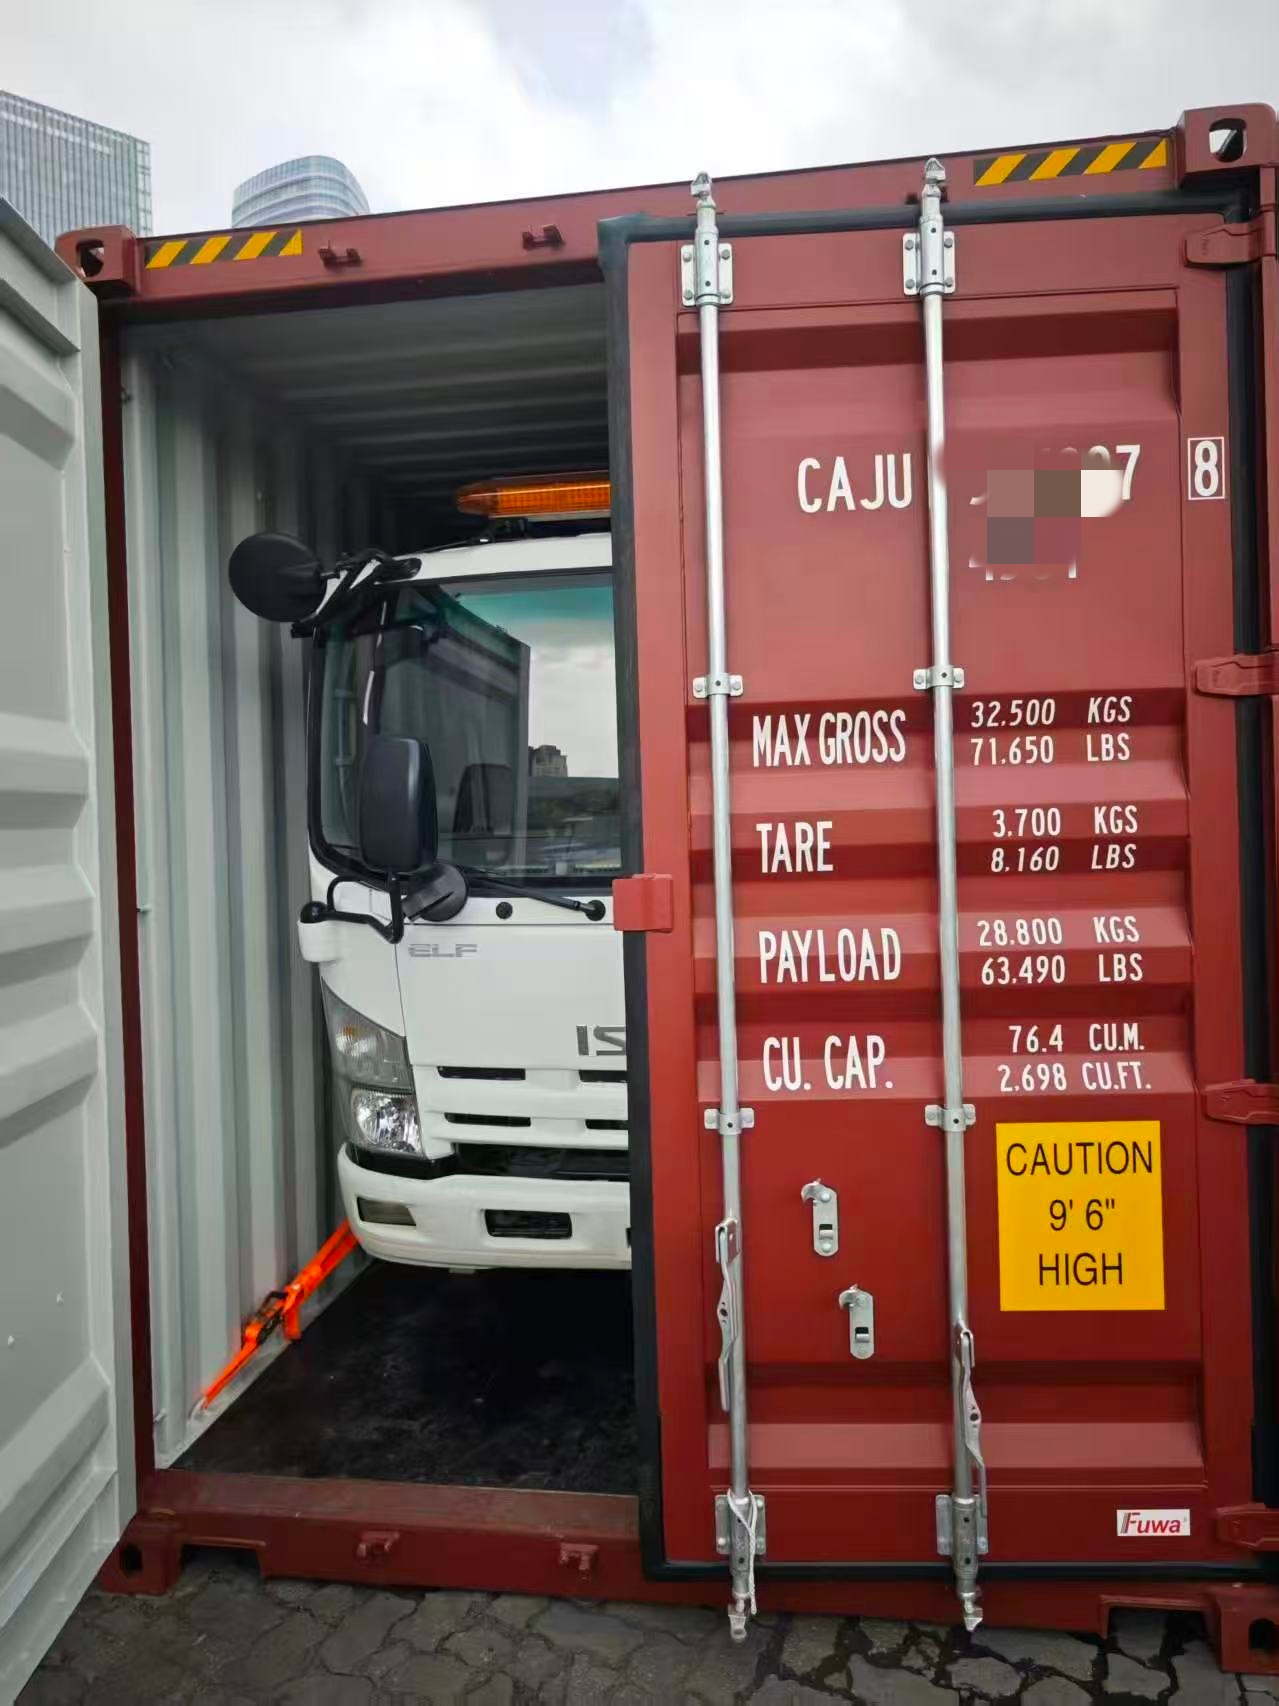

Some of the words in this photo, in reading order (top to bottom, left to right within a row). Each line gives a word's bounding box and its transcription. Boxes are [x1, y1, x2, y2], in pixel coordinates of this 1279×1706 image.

[797, 453, 913, 514] CAJU
[1194, 440, 1219, 497] 8
[1087, 695, 1132, 723] KGS
[752, 713, 812, 768] MAX
[818, 709, 907, 765] GROSS
[1086, 732, 1130, 762] LBS
[992, 807, 1061, 838] 3.700
[1094, 805, 1138, 834] KGS
[756, 820, 834, 873] TARE
[1091, 843, 1137, 869] LBS
[976, 917, 1063, 947] 28.800
[1093, 915, 1140, 943] KGS
[758, 927, 901, 984] PAYLOAD
[1098, 953, 1143, 982] LBS
[1009, 1024, 1063, 1053] 76.4
[1089, 1022, 1145, 1052] CU.M.
[762, 1036, 812, 1092] CU.
[824, 1035, 894, 1090] CAP.
[1081, 1061, 1152, 1091] CU.FT.
[1006, 1141, 1153, 1176] CAUTION
[1049, 1199, 1073, 1231] 9'
[1039, 1252, 1123, 1286] HIGH
[1121, 1512, 1182, 1534] Fuwa
